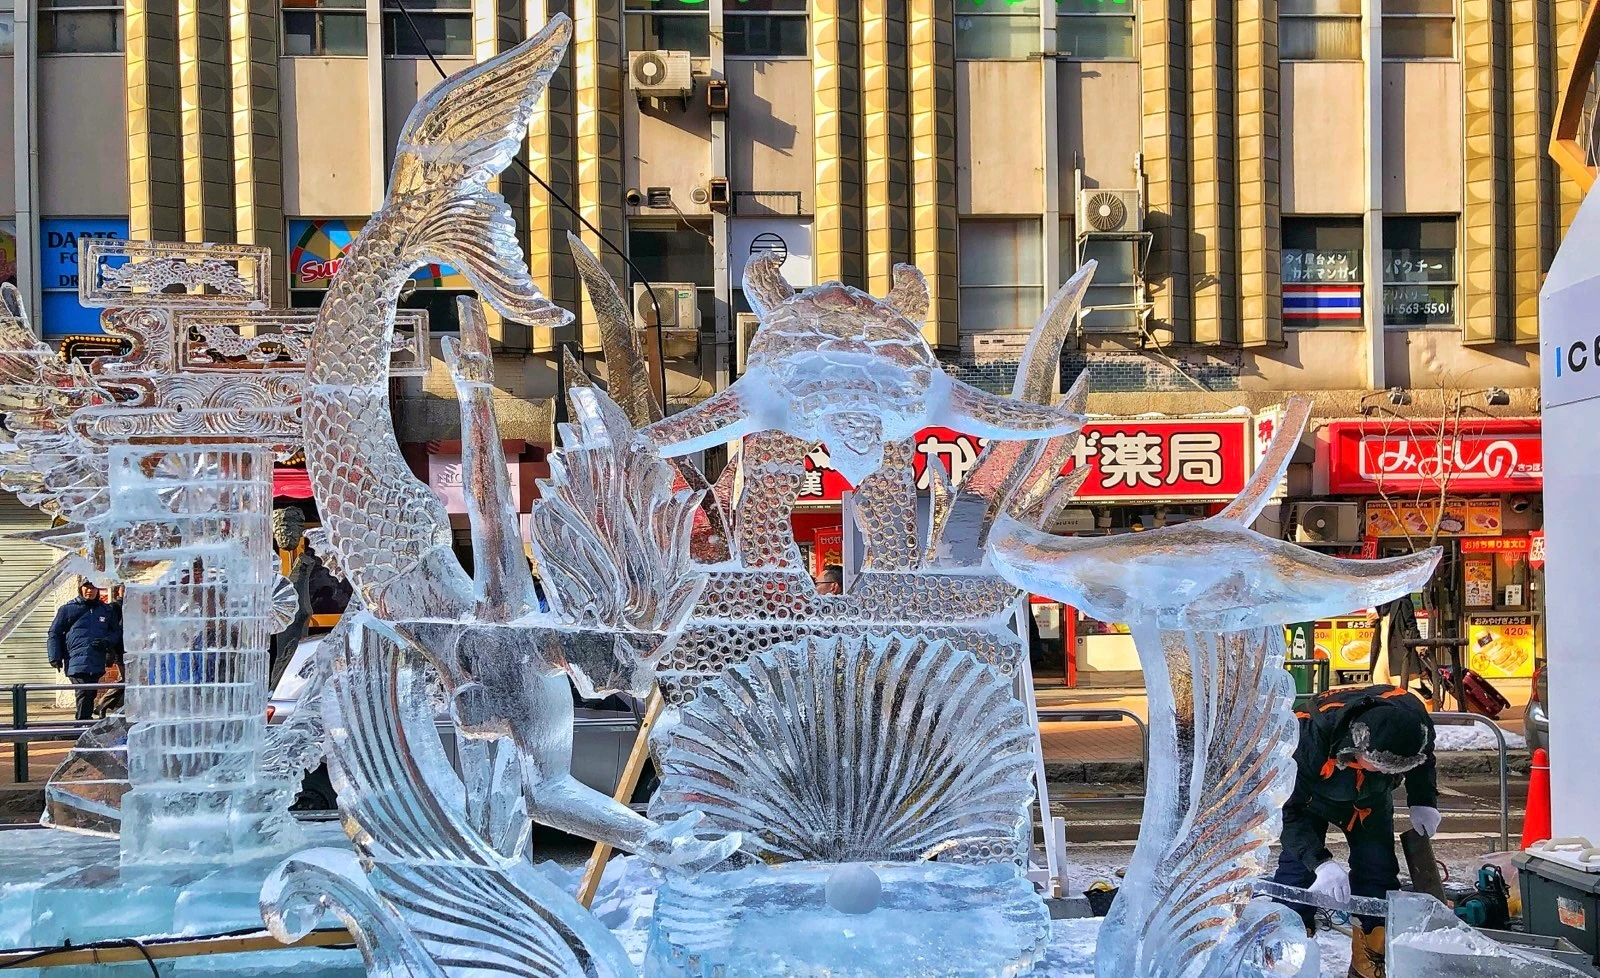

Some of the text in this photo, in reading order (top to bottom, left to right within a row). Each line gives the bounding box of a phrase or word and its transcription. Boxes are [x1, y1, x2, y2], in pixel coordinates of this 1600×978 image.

[60, 252, 108, 264] FOD
[1386, 259, 1442, 274] パクチー
[1378, 439, 1518, 478] みよしの
